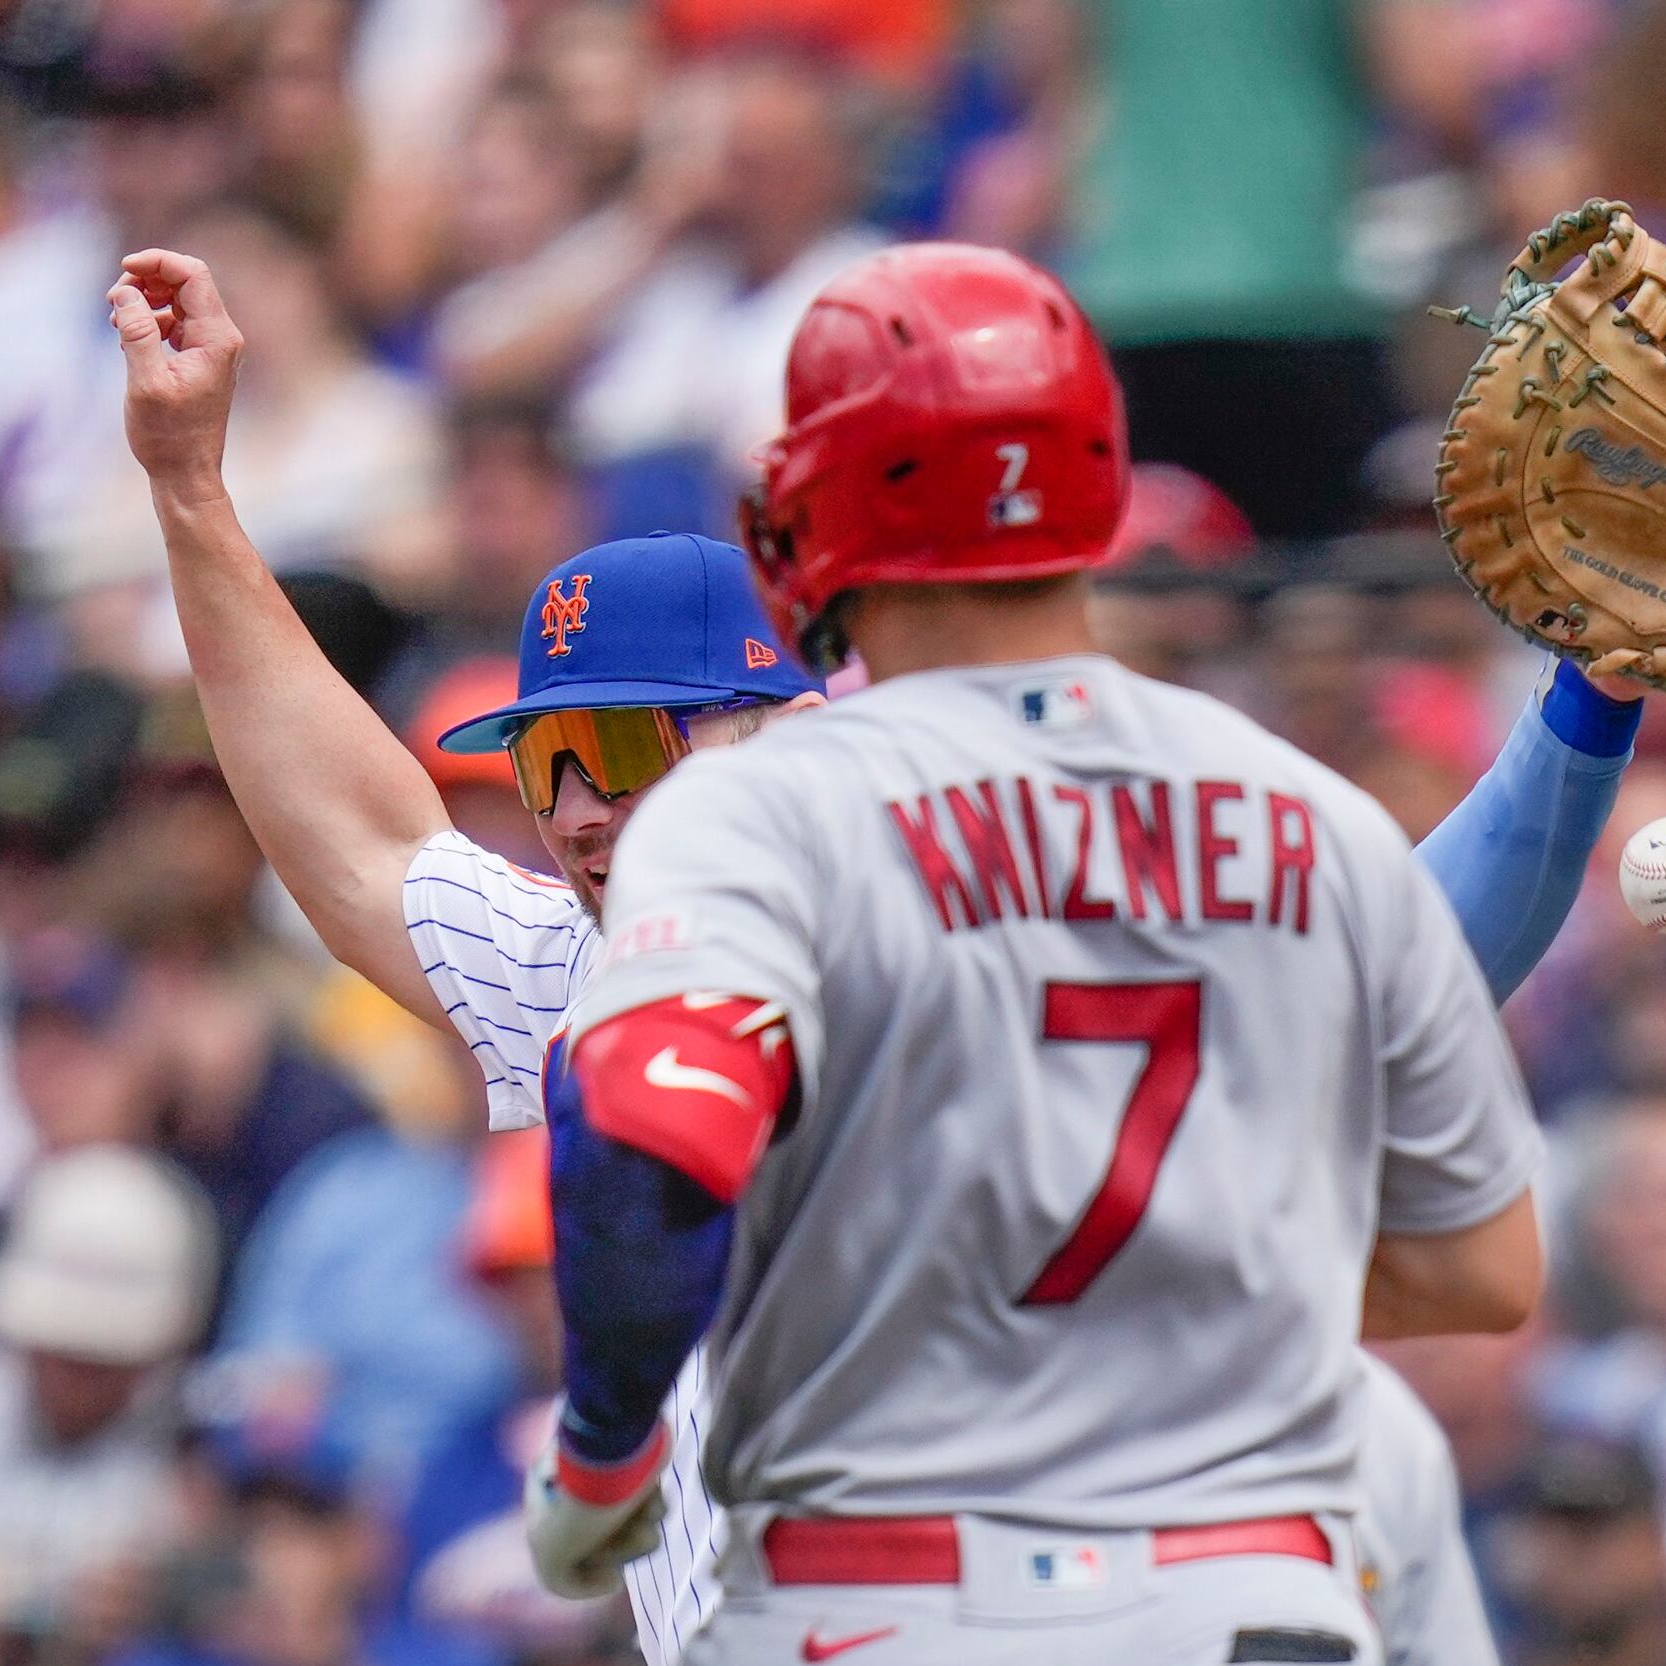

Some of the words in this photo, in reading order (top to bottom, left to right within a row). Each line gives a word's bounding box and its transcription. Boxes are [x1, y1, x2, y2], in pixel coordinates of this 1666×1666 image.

[994, 442, 1030, 492] 7
[889, 777, 1317, 936] KNIZNER
[1018, 979, 1203, 1307] 7
